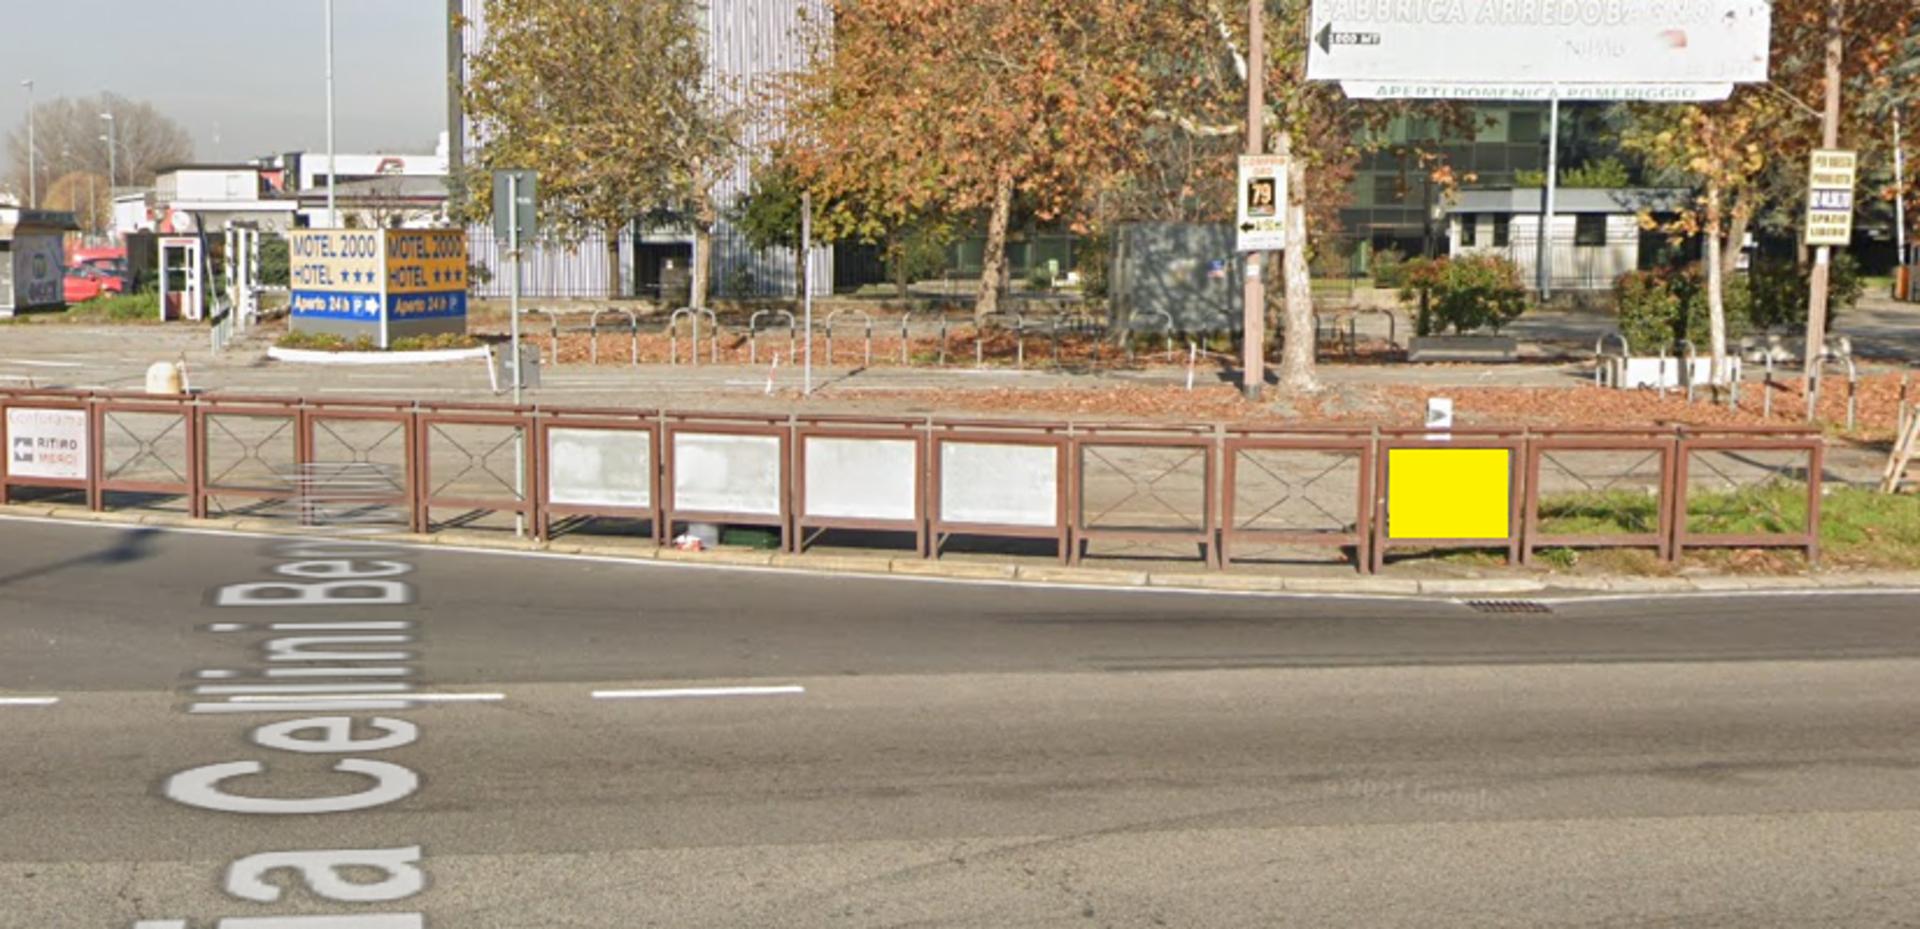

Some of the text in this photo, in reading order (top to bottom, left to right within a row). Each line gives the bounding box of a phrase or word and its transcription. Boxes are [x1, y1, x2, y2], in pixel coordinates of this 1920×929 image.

[1317, 0, 1466, 24] FABBRICA
[1376, 85, 1447, 96] APERTI
[1452, 86, 1559, 98] DOMENICA
[1252, 183, 1272, 204] 79
[293, 234, 376, 258] MOTEL 2000
[388, 235, 462, 259] MOTEL 2000
[293, 264, 335, 286] HOTEL
[390, 264, 428, 288] HOTEL
[294, 295, 327, 312] Aperto
[394, 297, 425, 316] Aperto
[37, 437, 78, 451] RITIRO
